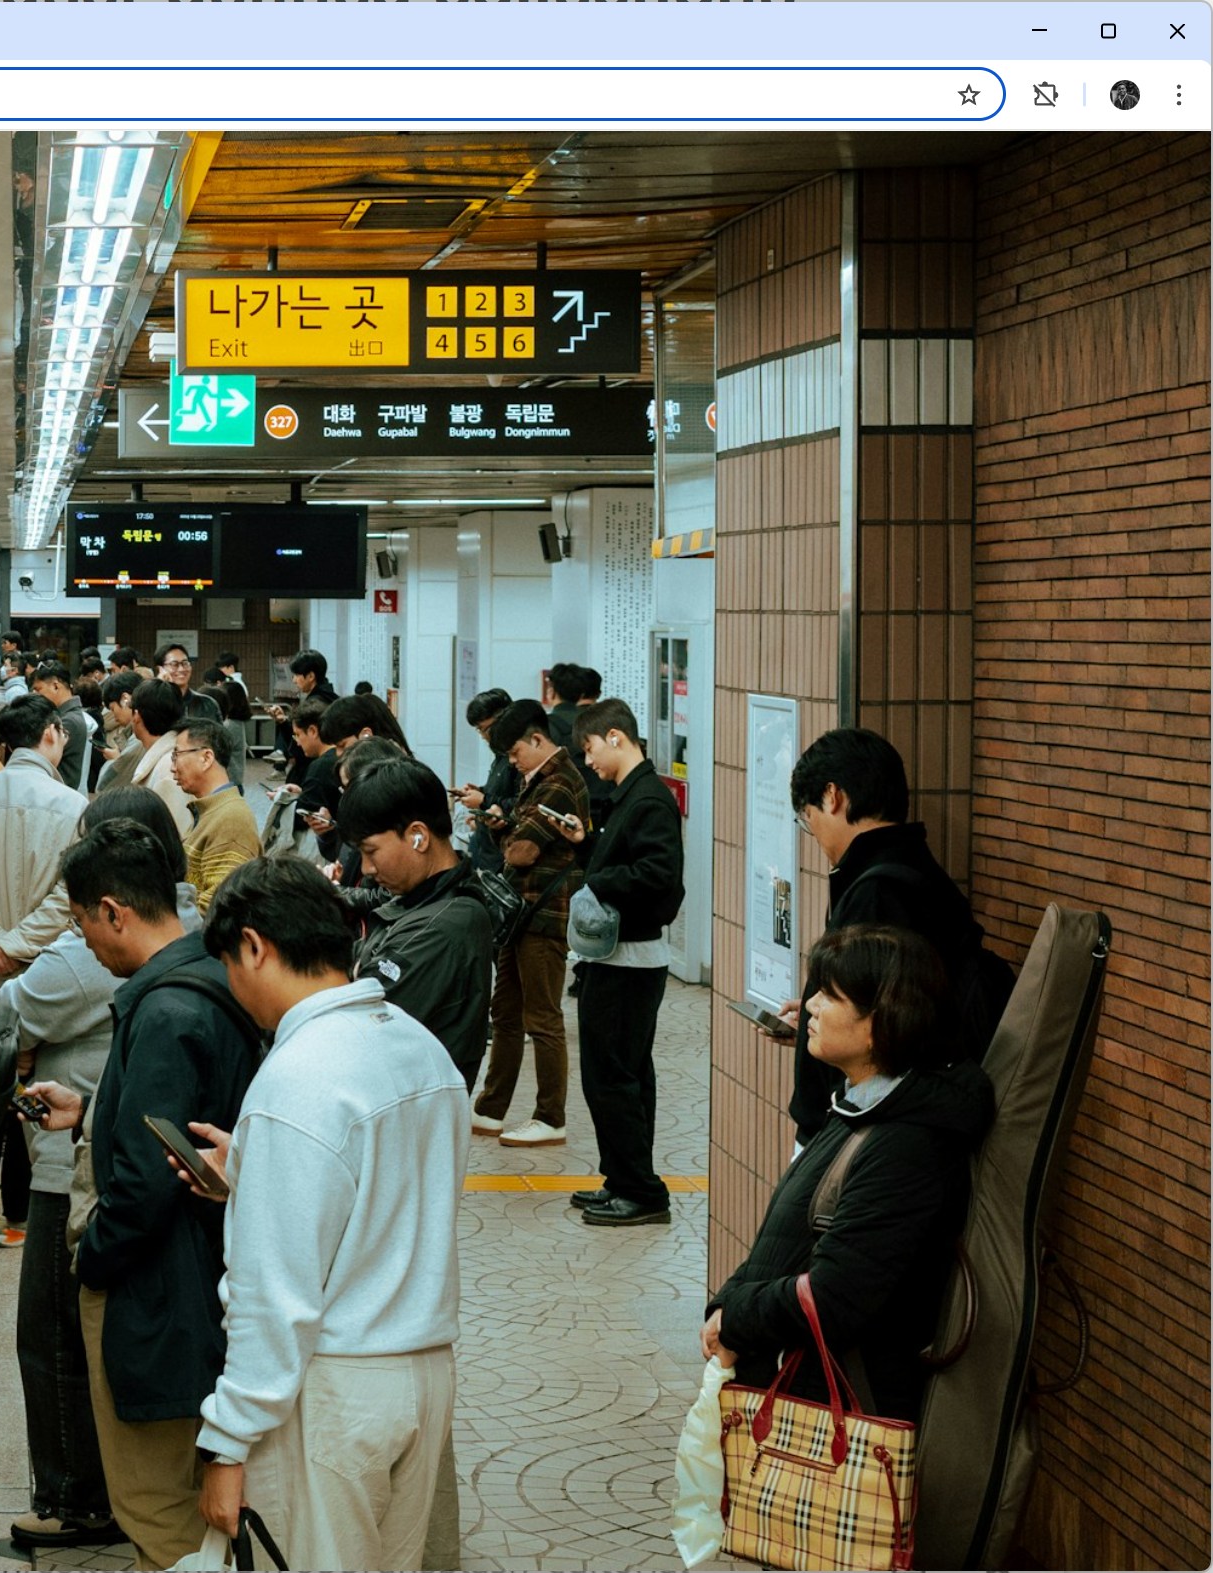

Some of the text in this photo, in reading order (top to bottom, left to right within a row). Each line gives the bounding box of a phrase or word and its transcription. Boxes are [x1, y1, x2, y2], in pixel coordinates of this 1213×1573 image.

[210, 285, 383, 329] 나가는 곳
[439, 293, 526, 311] 1 2 3
[210, 339, 247, 357] Exit
[350, 340, 382, 356] 出口
[435, 334, 525, 352] 4 5 6
[270, 416, 292, 428] 327
[324, 404, 554, 423] 대화 구파발 불광 독립문
[324, 427, 570, 439] Daehwa Gupabal Bulgwang Dongnimmun
[178, 531, 208, 541] 00:56
